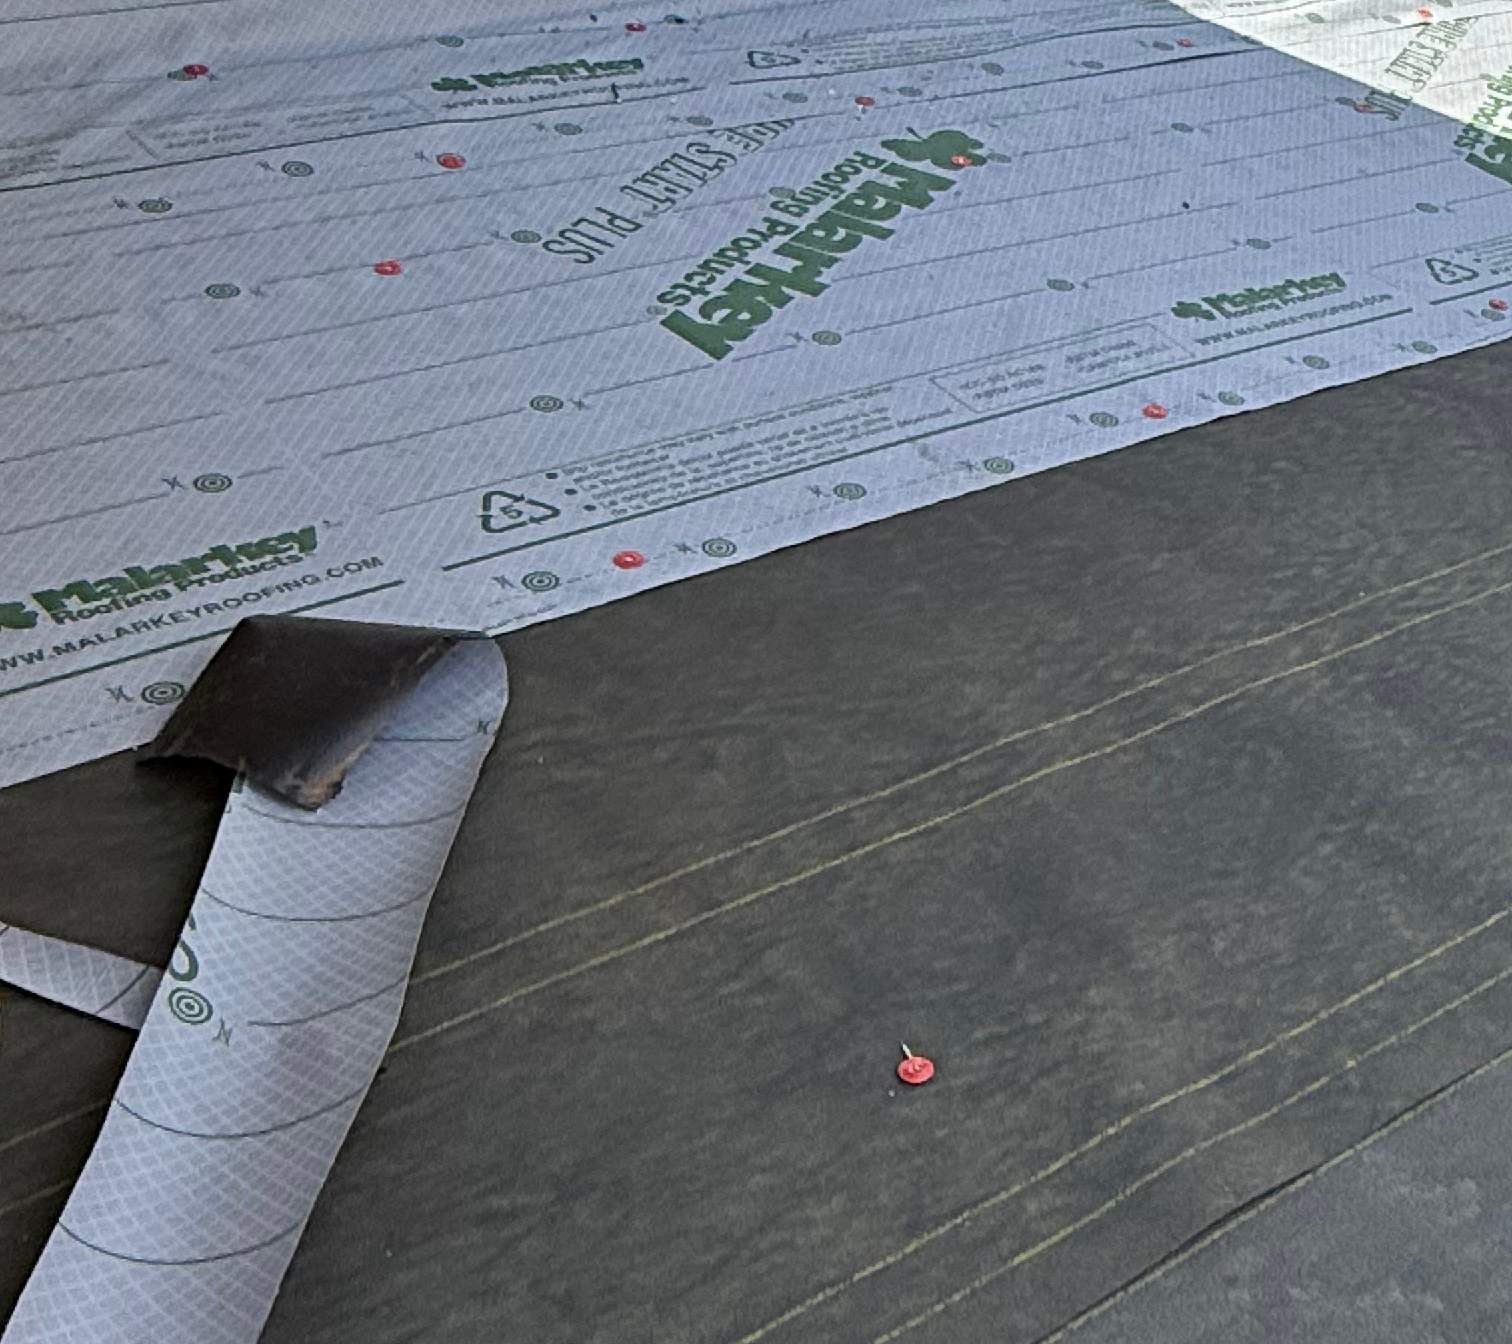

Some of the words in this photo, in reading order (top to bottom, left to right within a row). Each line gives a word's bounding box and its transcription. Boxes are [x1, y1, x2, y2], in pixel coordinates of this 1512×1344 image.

[769, 150, 888, 217] Roofing
[543, 207, 643, 265] PLUS
[660, 162, 957, 361] Malarkey
[31, 525, 318, 613] Malarkey
[50, 587, 172, 625] Roofing
